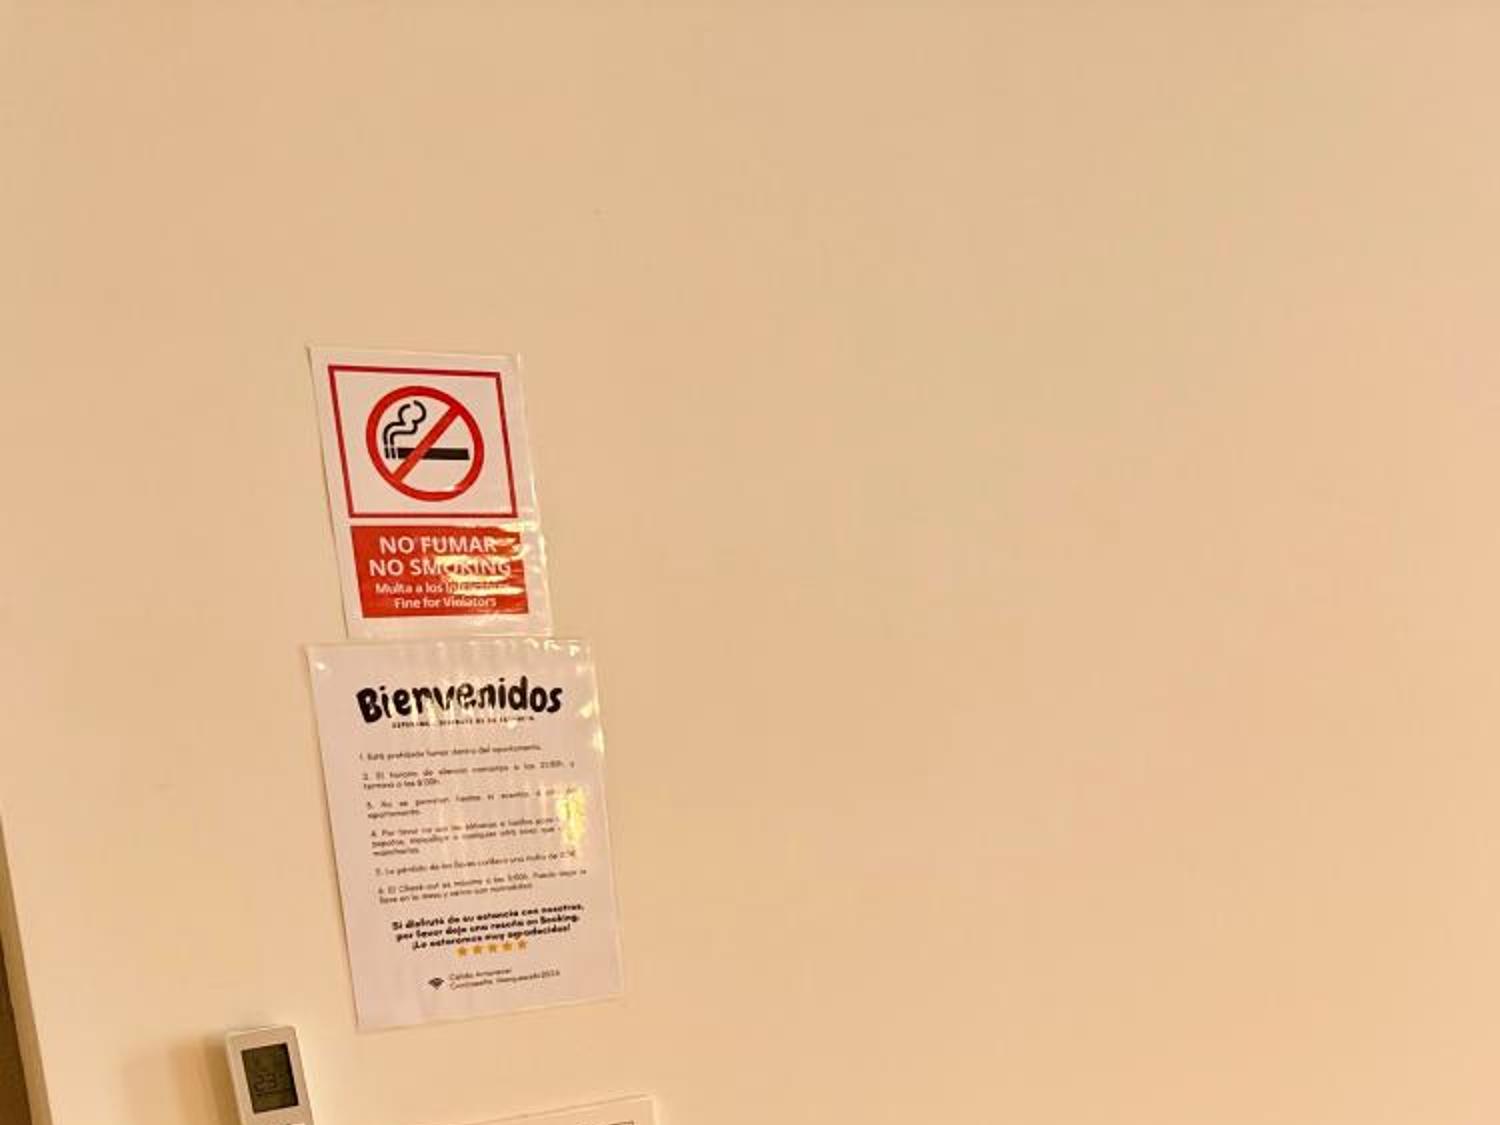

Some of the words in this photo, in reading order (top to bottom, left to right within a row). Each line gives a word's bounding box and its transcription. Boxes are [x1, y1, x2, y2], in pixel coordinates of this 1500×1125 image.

[379, 536, 415, 554] NO
[421, 536, 497, 554] FUMAR
[368, 559, 404, 576] NO
[409, 557, 512, 576] SMOKING
[375, 583, 413, 593] Multa
[415, 585, 423, 593] a
[425, 582, 443, 592] los
[394, 598, 421, 608] Fine
[423, 598, 441, 607] for
[443, 597, 497, 606] Violators
[356, 675, 563, 724] Bienvenidos
[392, 921, 403, 931] Si
